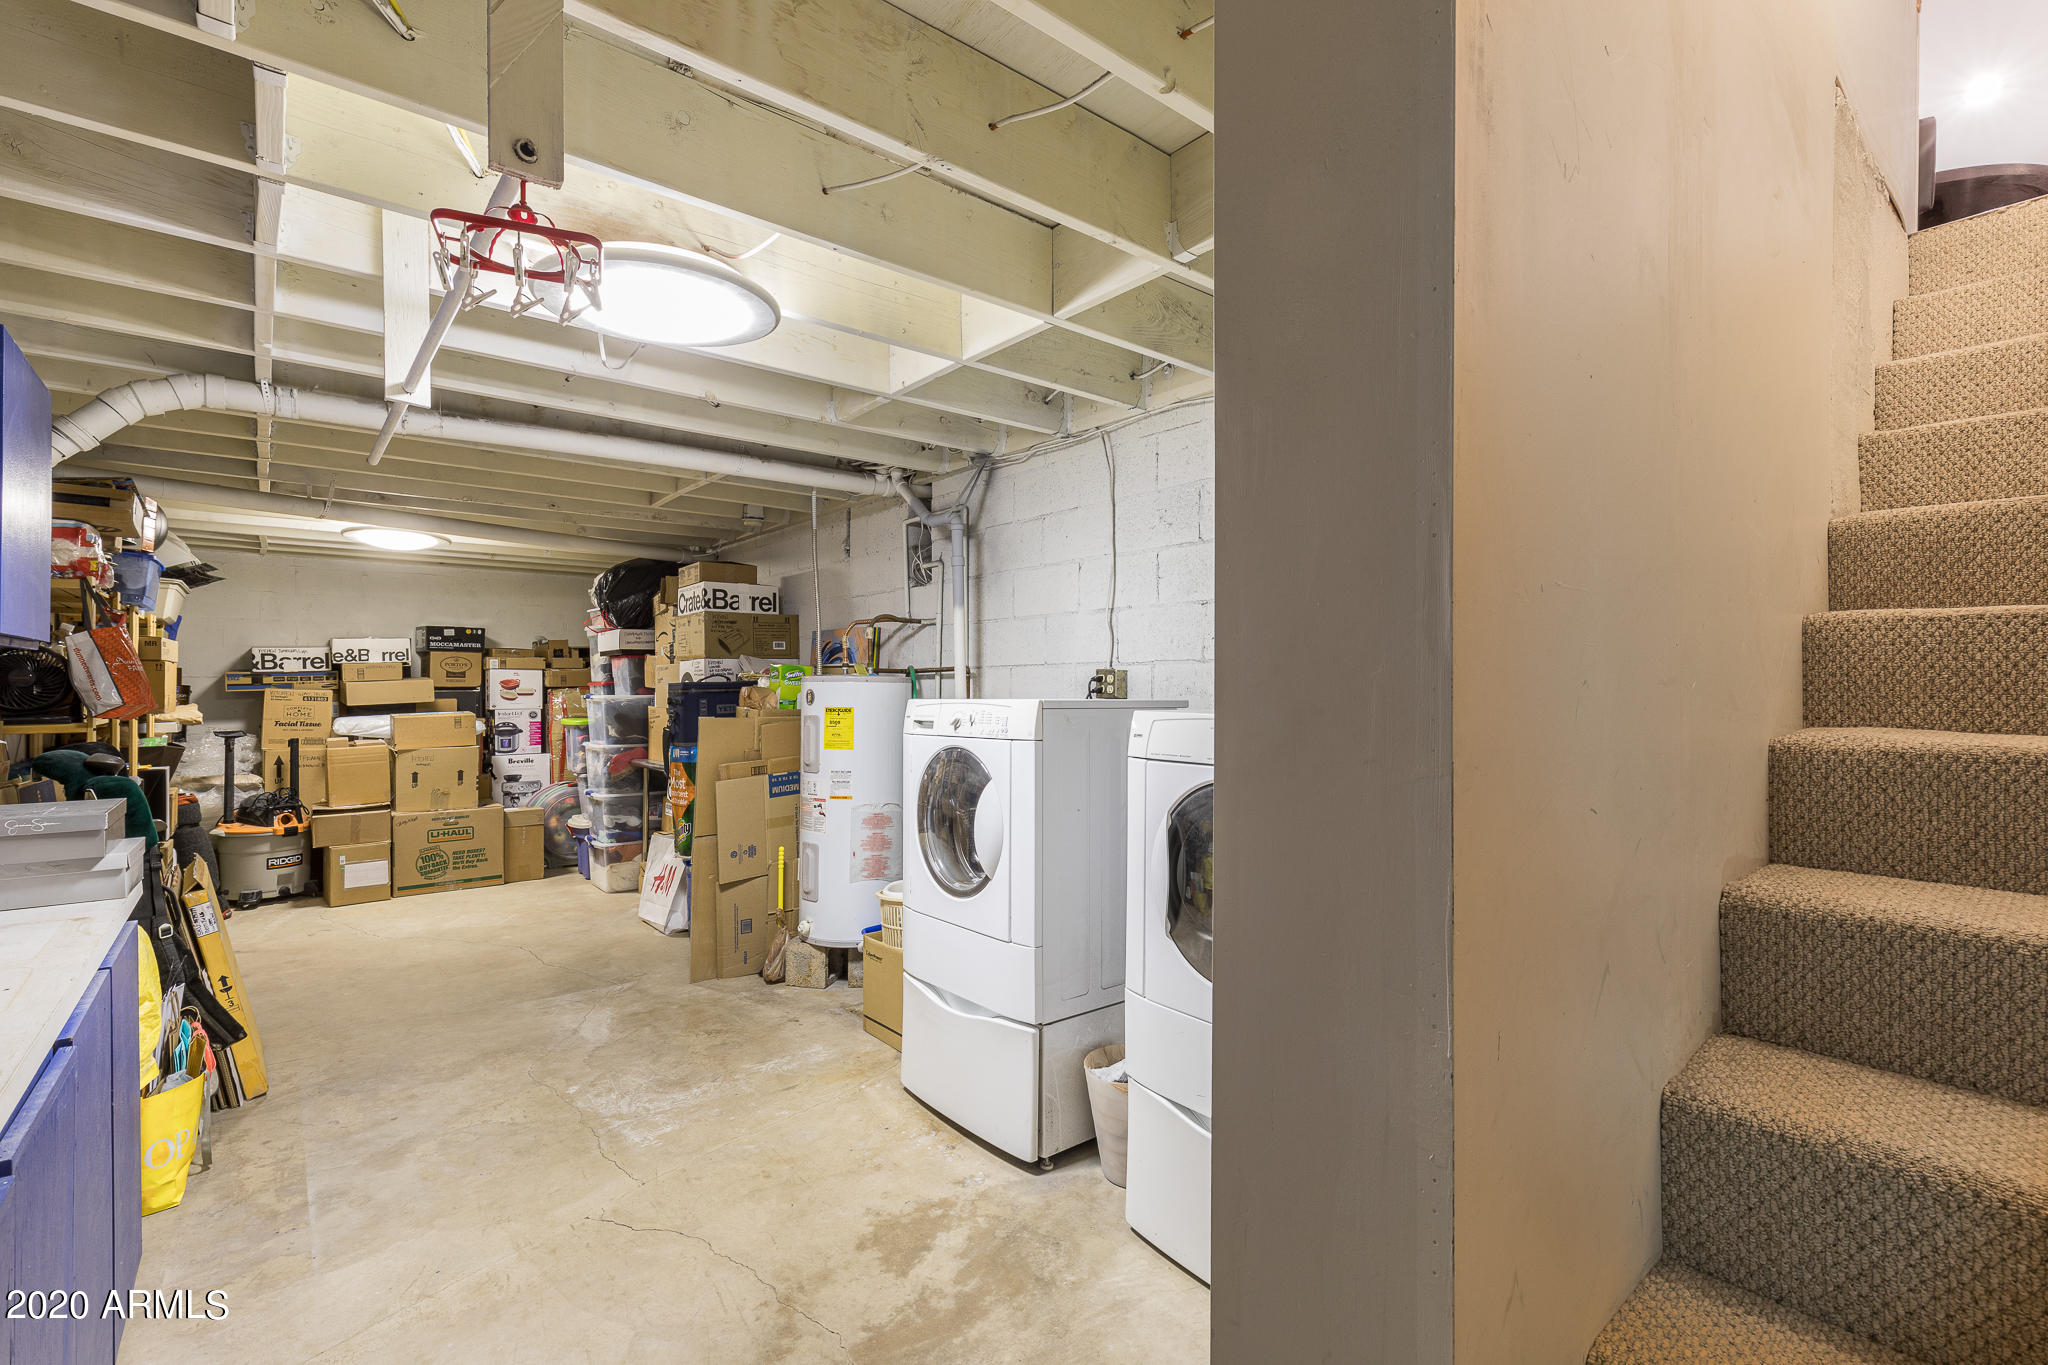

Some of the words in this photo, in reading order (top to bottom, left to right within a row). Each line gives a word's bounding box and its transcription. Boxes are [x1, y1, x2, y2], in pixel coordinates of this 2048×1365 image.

[299, 720, 322, 728] Tissue
[430, 828, 472, 838] U-HAUL
[268, 855, 302, 866] RIDGID
[420, 851, 445, 864] 100%
